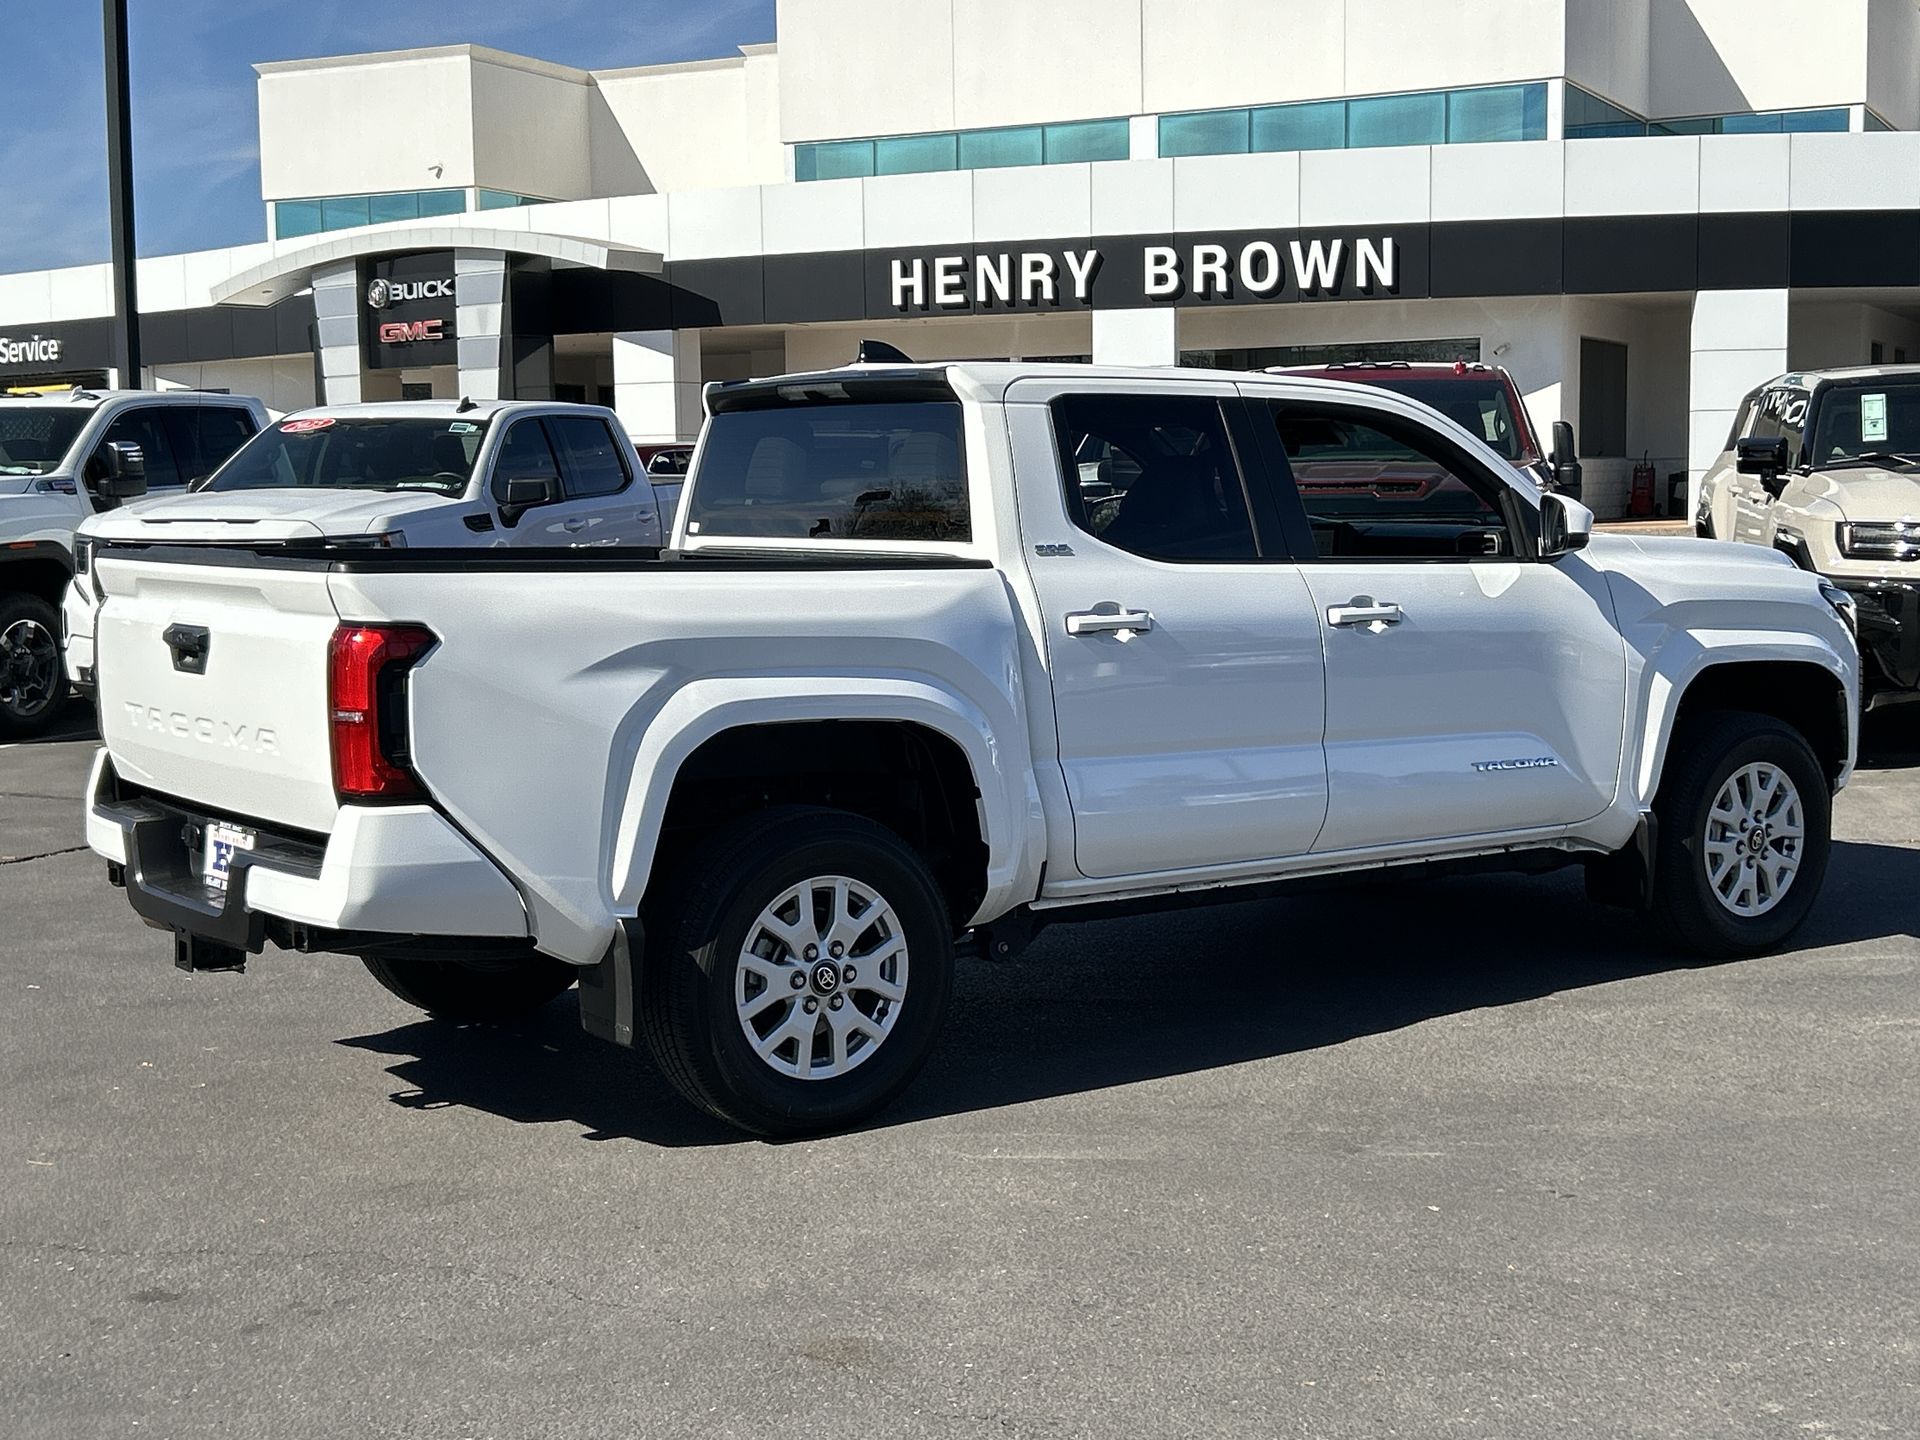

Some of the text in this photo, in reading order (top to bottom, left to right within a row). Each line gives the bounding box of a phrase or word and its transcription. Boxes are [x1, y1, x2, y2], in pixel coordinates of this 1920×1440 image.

[891, 236, 1394, 306] HENRY BROWN
[389, 279, 454, 301] BUICK
[380, 319, 443, 343] GMC
[0, 335, 59, 364] Service
[125, 701, 281, 757] TACOMA
[1471, 756, 1559, 772] TACOMA
